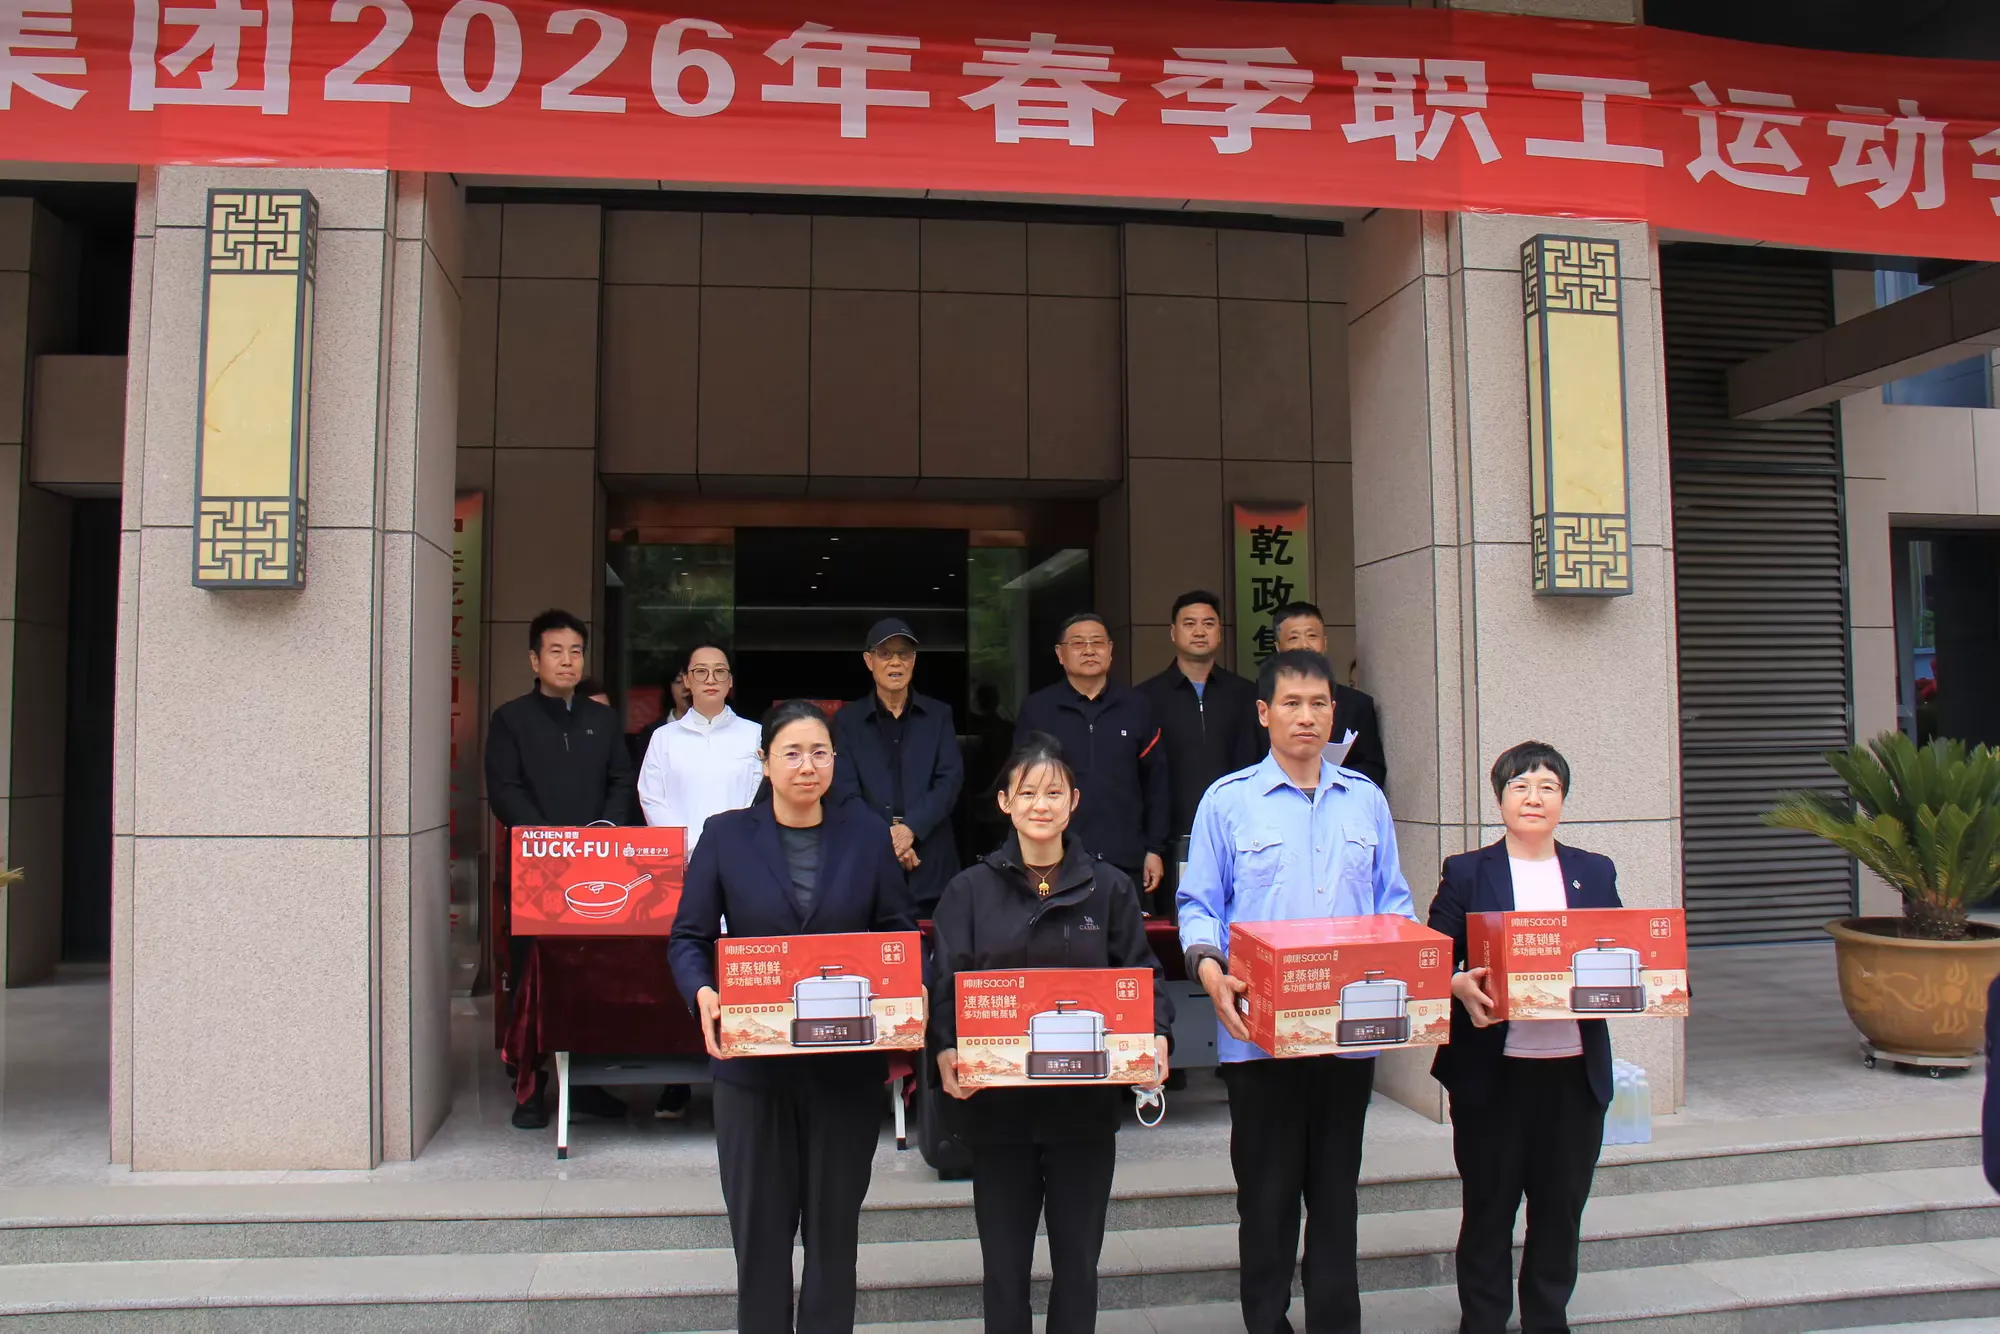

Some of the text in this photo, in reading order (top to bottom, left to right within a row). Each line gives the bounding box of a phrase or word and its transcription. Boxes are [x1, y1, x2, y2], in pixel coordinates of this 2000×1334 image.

[522, 831, 563, 839] AICHEN
[522, 841, 610, 858] LUCK-FU
[1512, 933, 1561, 947] 速蒸锁鲜
[1512, 947, 1561, 956] 多功能电蒸锅
[726, 961, 781, 976] 速蒸锁鲜
[726, 976, 782, 987] 多功能电蒸锅
[1283, 967, 1331, 984] 速蒸锁鲜
[1282, 982, 1331, 994] 多功能电蒸锅
[964, 995, 1018, 1009] 速蒸锁鲜
[964, 1009, 1018, 1020] 多功能电蒸锅
